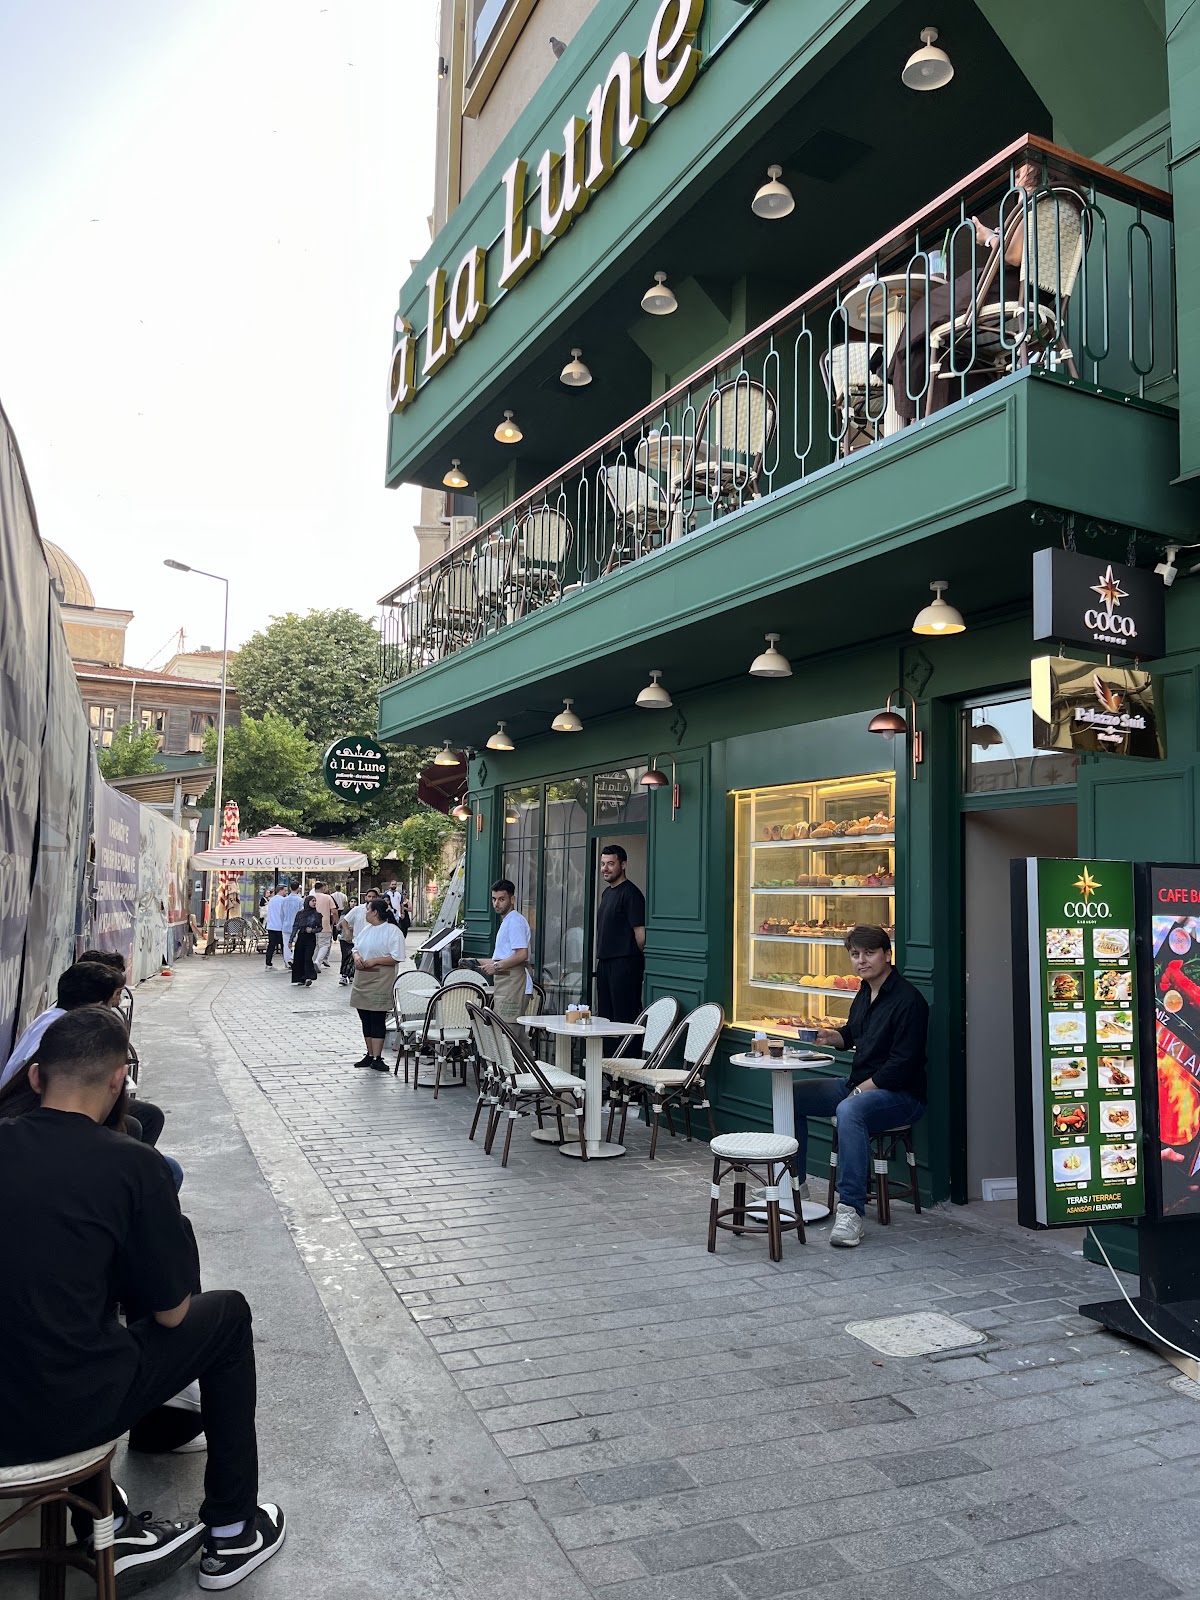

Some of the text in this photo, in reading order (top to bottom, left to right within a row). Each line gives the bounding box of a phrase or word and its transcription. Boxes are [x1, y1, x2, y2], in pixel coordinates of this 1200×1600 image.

[386, 0, 694, 414] à La Lune
[1074, 707, 1146, 729] Palazzo Suit
[329, 758, 386, 772] à La Lune
[1158, 888, 1200, 903] CAFE B
[1066, 1195, 1088, 1205] TERAS
[1092, 1192, 1121, 1202] TERRACE
[1066, 1205, 1092, 1214] ASANSÖR
[1095, 1203, 1123, 1211] ELEVATOR
